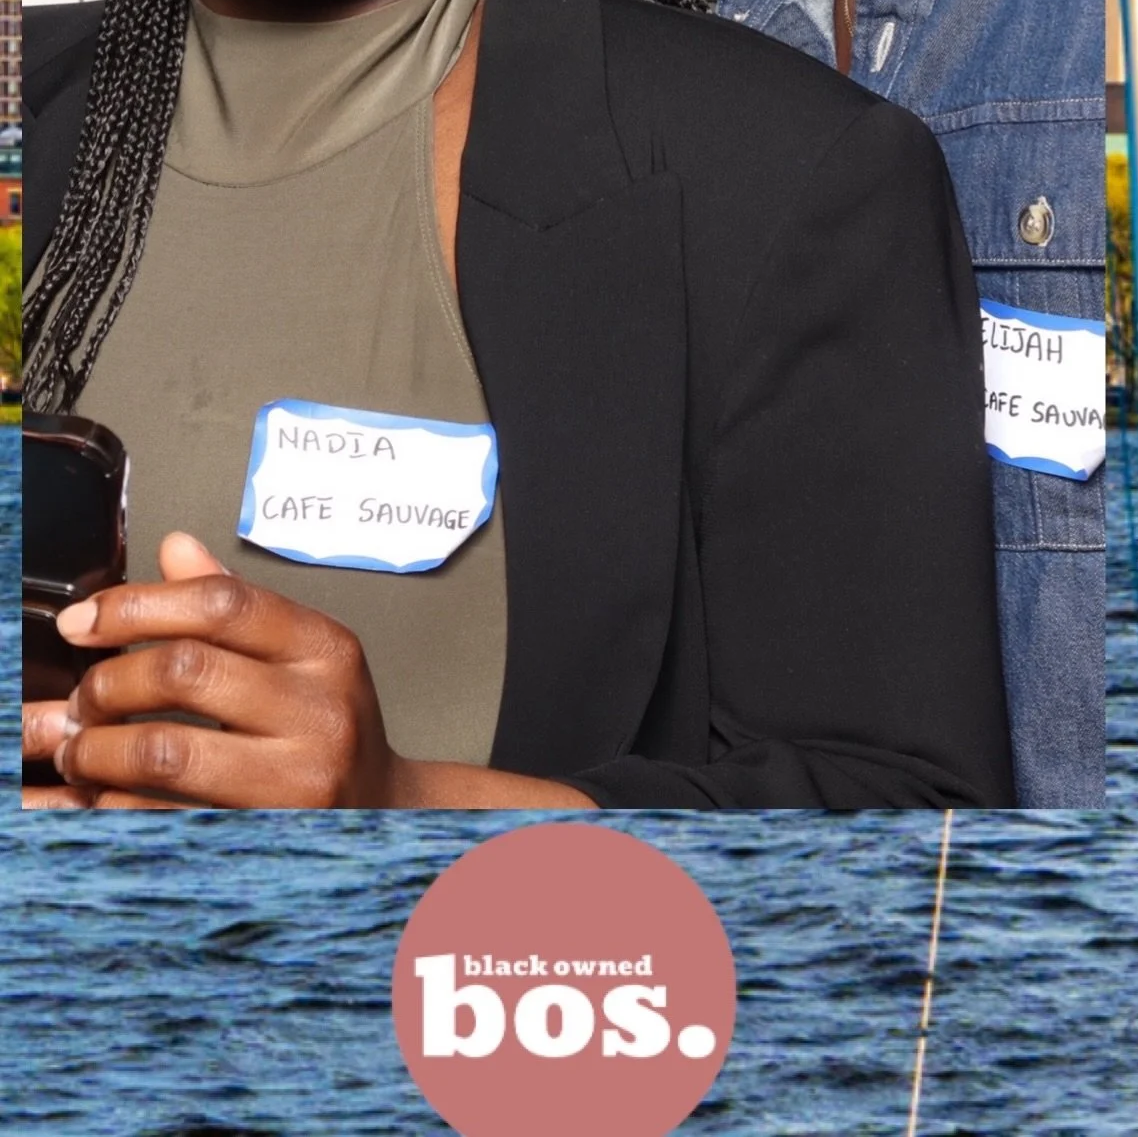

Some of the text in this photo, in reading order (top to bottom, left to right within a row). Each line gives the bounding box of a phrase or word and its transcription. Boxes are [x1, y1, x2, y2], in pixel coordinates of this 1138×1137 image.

[984, 388, 1105, 429] AFE SAUVA
[278, 426, 396, 460] NADIA
[262, 495, 470, 530] CAFE SAUVAGE
